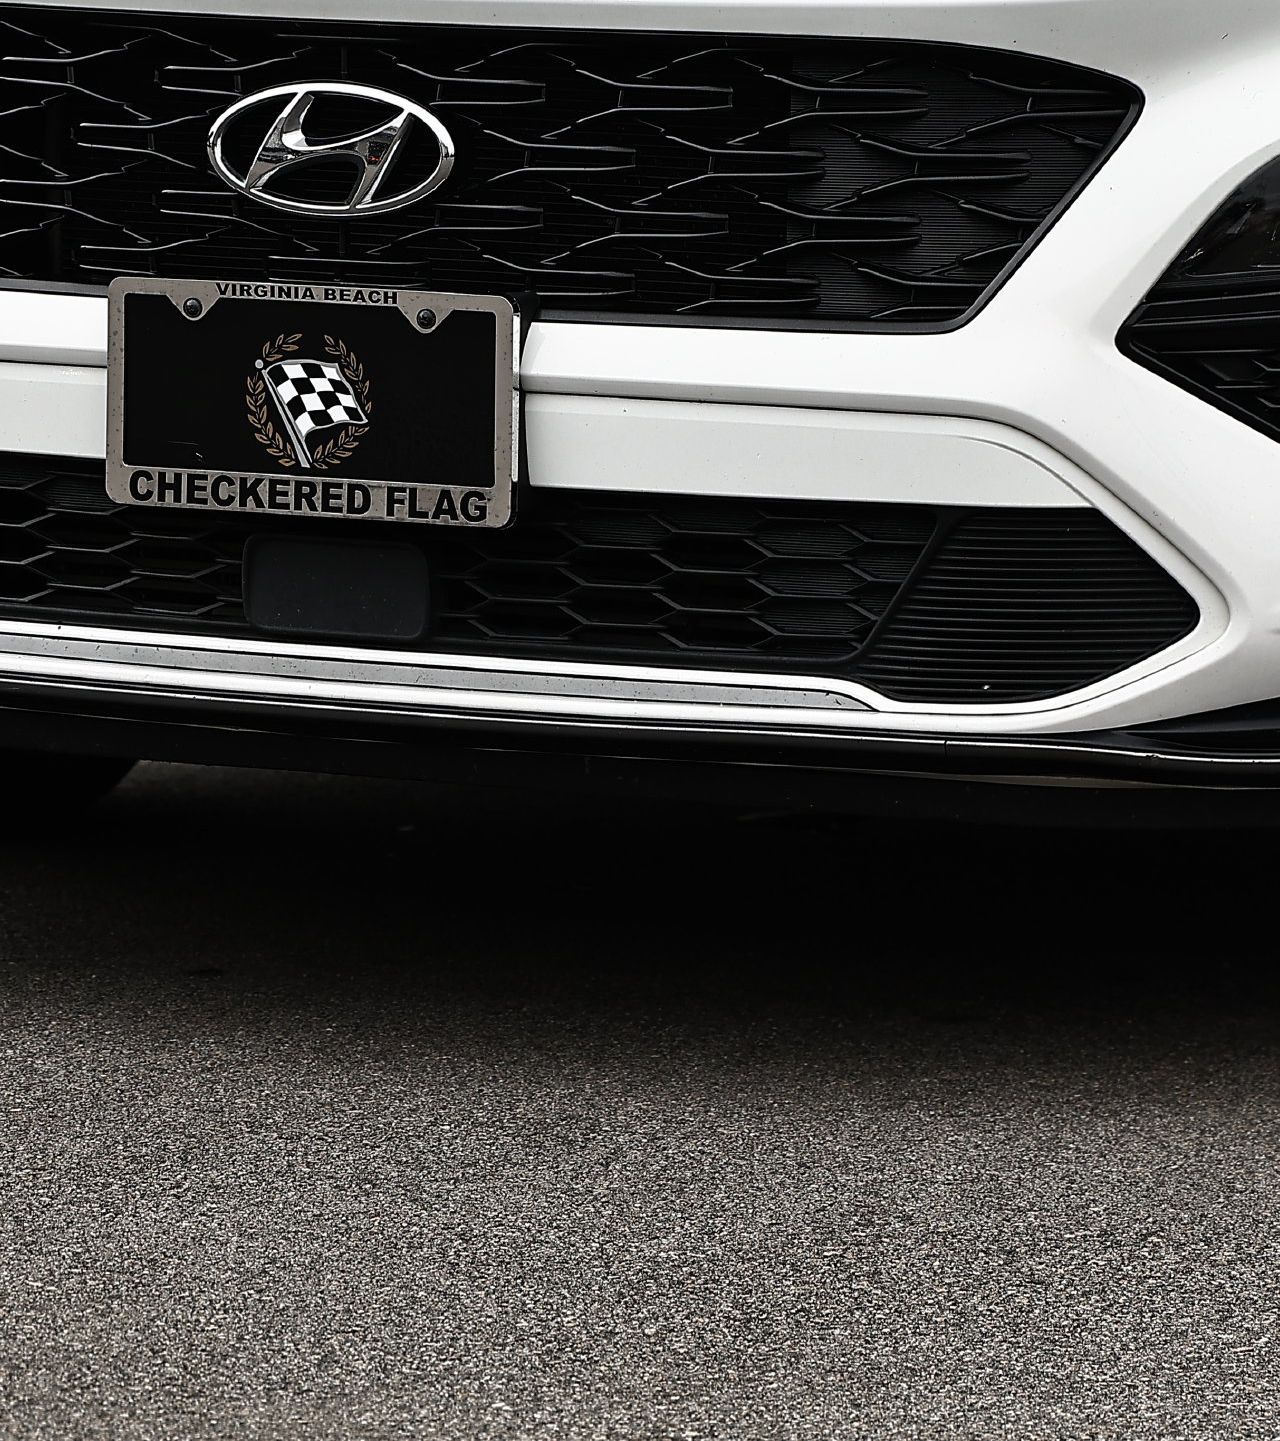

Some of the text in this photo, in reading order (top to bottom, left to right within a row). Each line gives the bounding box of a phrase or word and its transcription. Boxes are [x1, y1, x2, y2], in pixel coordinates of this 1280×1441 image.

[216, 282, 398, 305] VIRGINIA BEACH
[128, 469, 489, 523] CHECKERED FLAG
